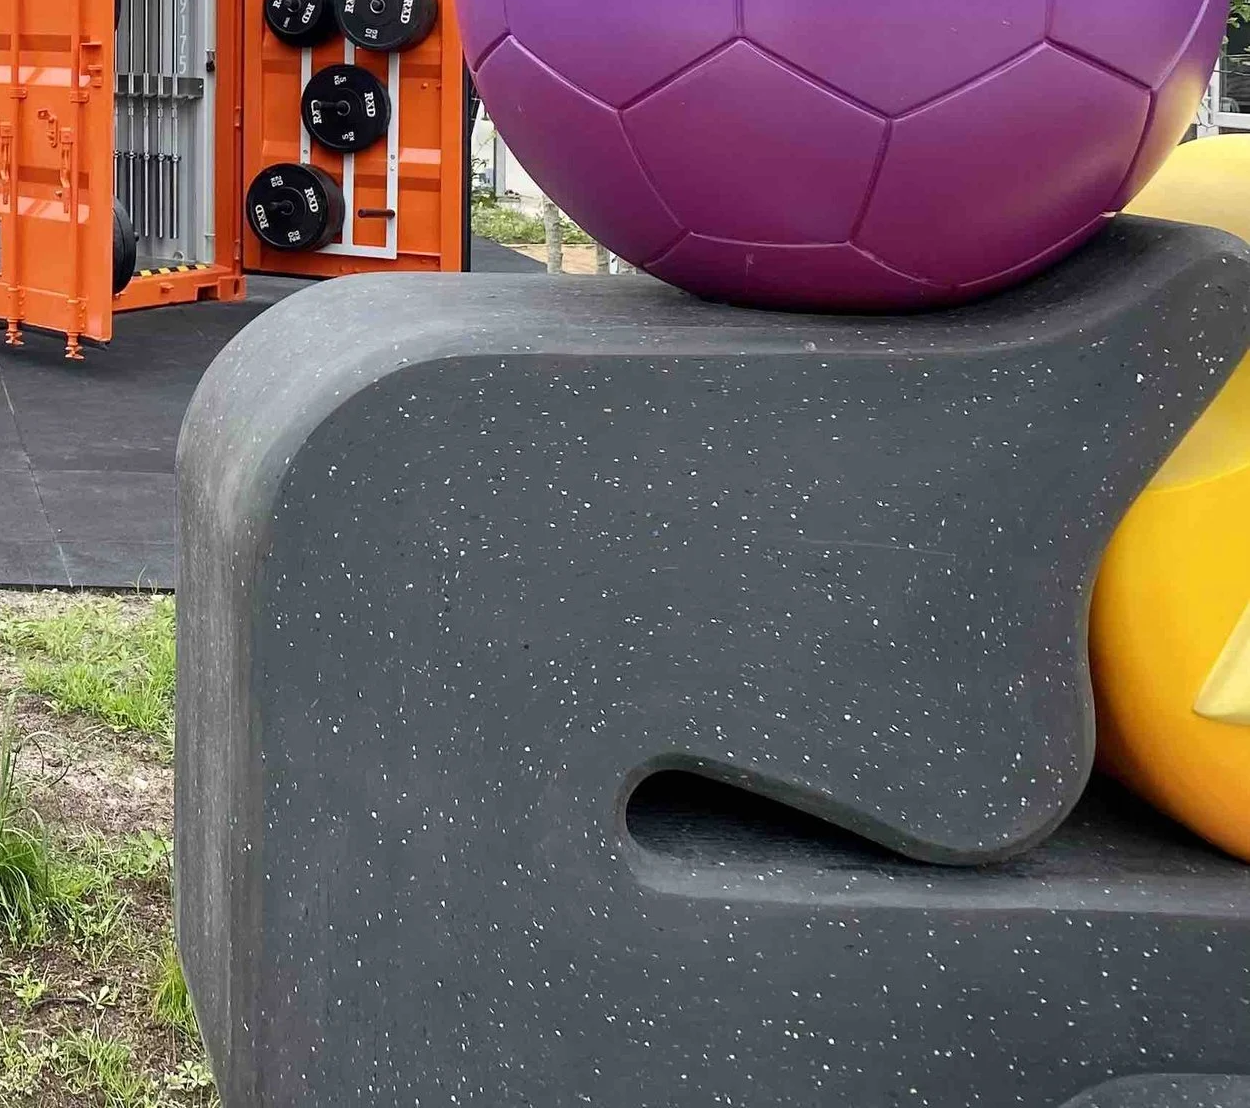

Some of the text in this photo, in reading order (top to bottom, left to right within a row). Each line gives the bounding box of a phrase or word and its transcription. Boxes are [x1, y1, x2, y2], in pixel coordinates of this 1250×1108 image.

[301, 2, 315, 24] RXD
[364, 28, 373, 38] 10
[364, 91, 376, 117] RXD
[276, 175, 284, 186] 20
[304, 187, 319, 213] RXD
[255, 204, 269, 230] RXD
